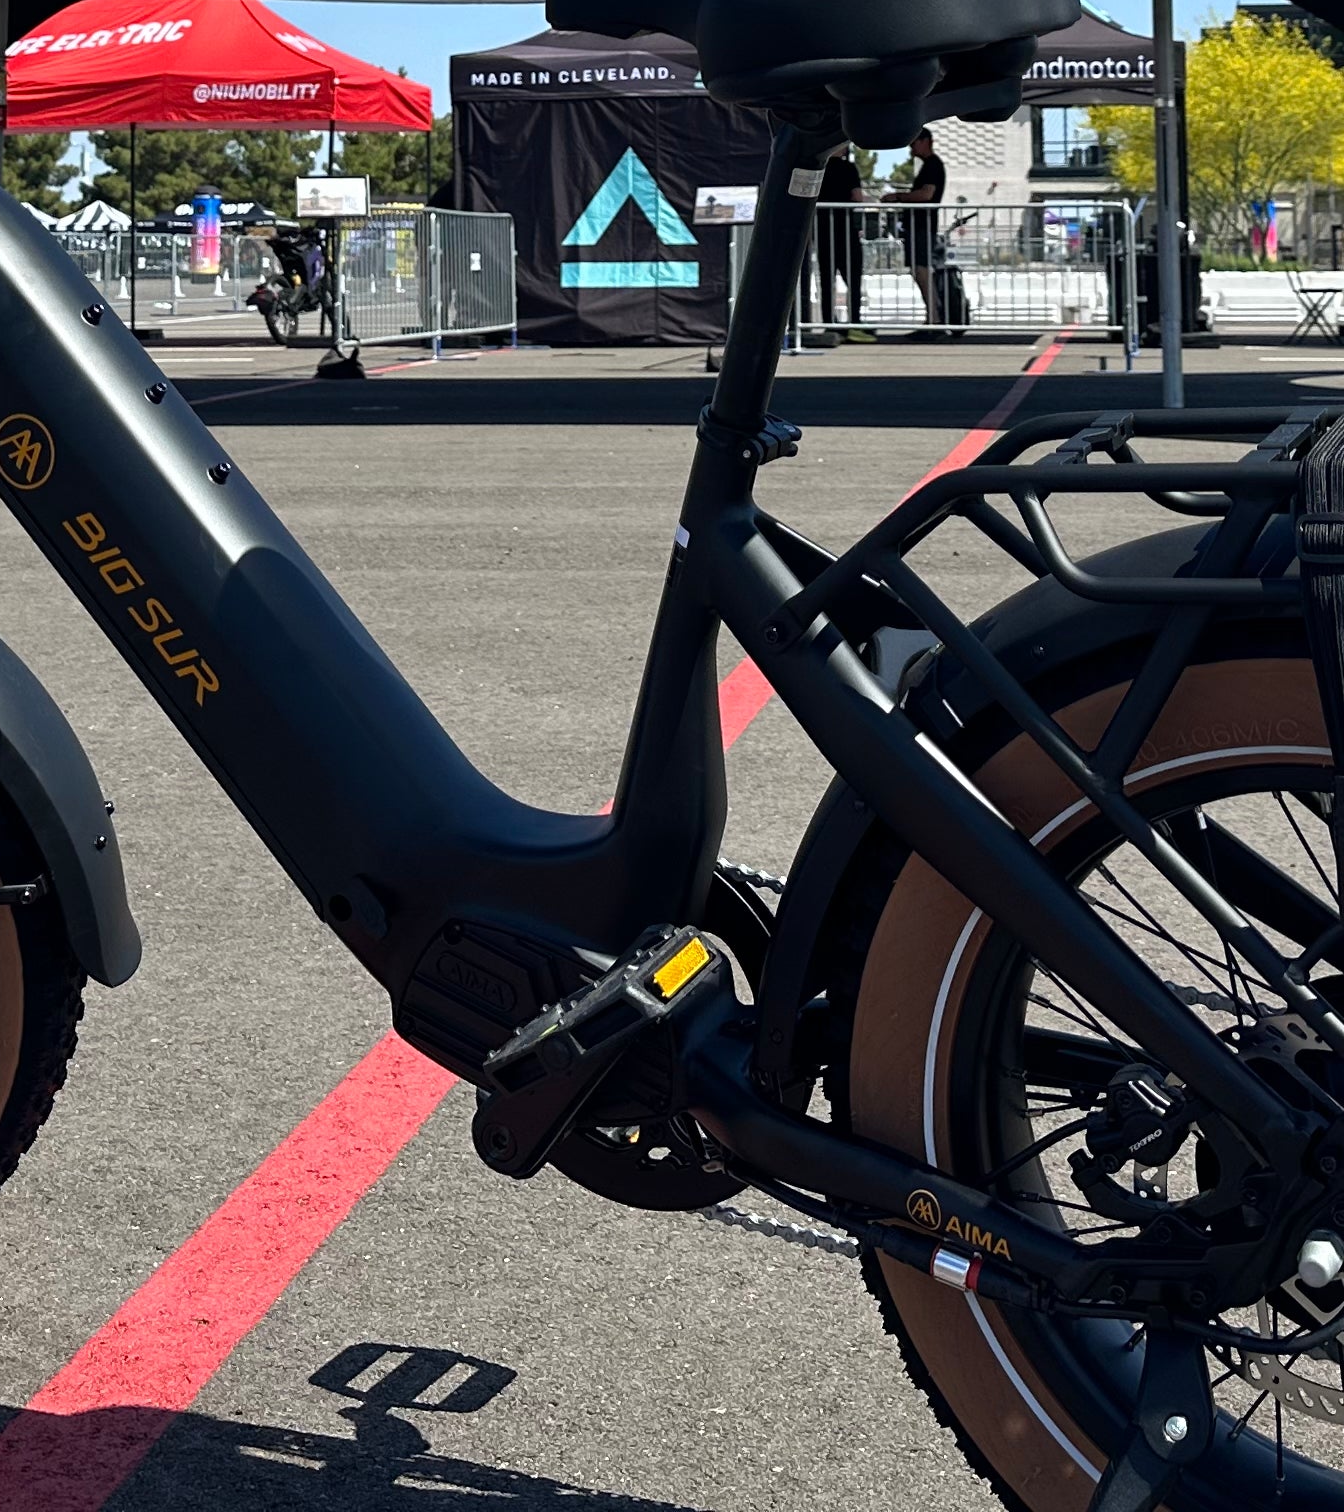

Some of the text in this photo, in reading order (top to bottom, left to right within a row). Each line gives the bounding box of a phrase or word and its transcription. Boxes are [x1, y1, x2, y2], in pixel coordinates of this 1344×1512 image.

[46, 19, 192, 53] ELECTRIC
[470, 66, 677, 86] MADE IN CLEVELAND.
[193, 82, 321, 104] @NIUMOBILITY
[62, 512, 220, 707] BIG SUR
[1128, 1128, 1163, 1153] TEKTRO
[945, 1215, 1013, 1262] AIMA
